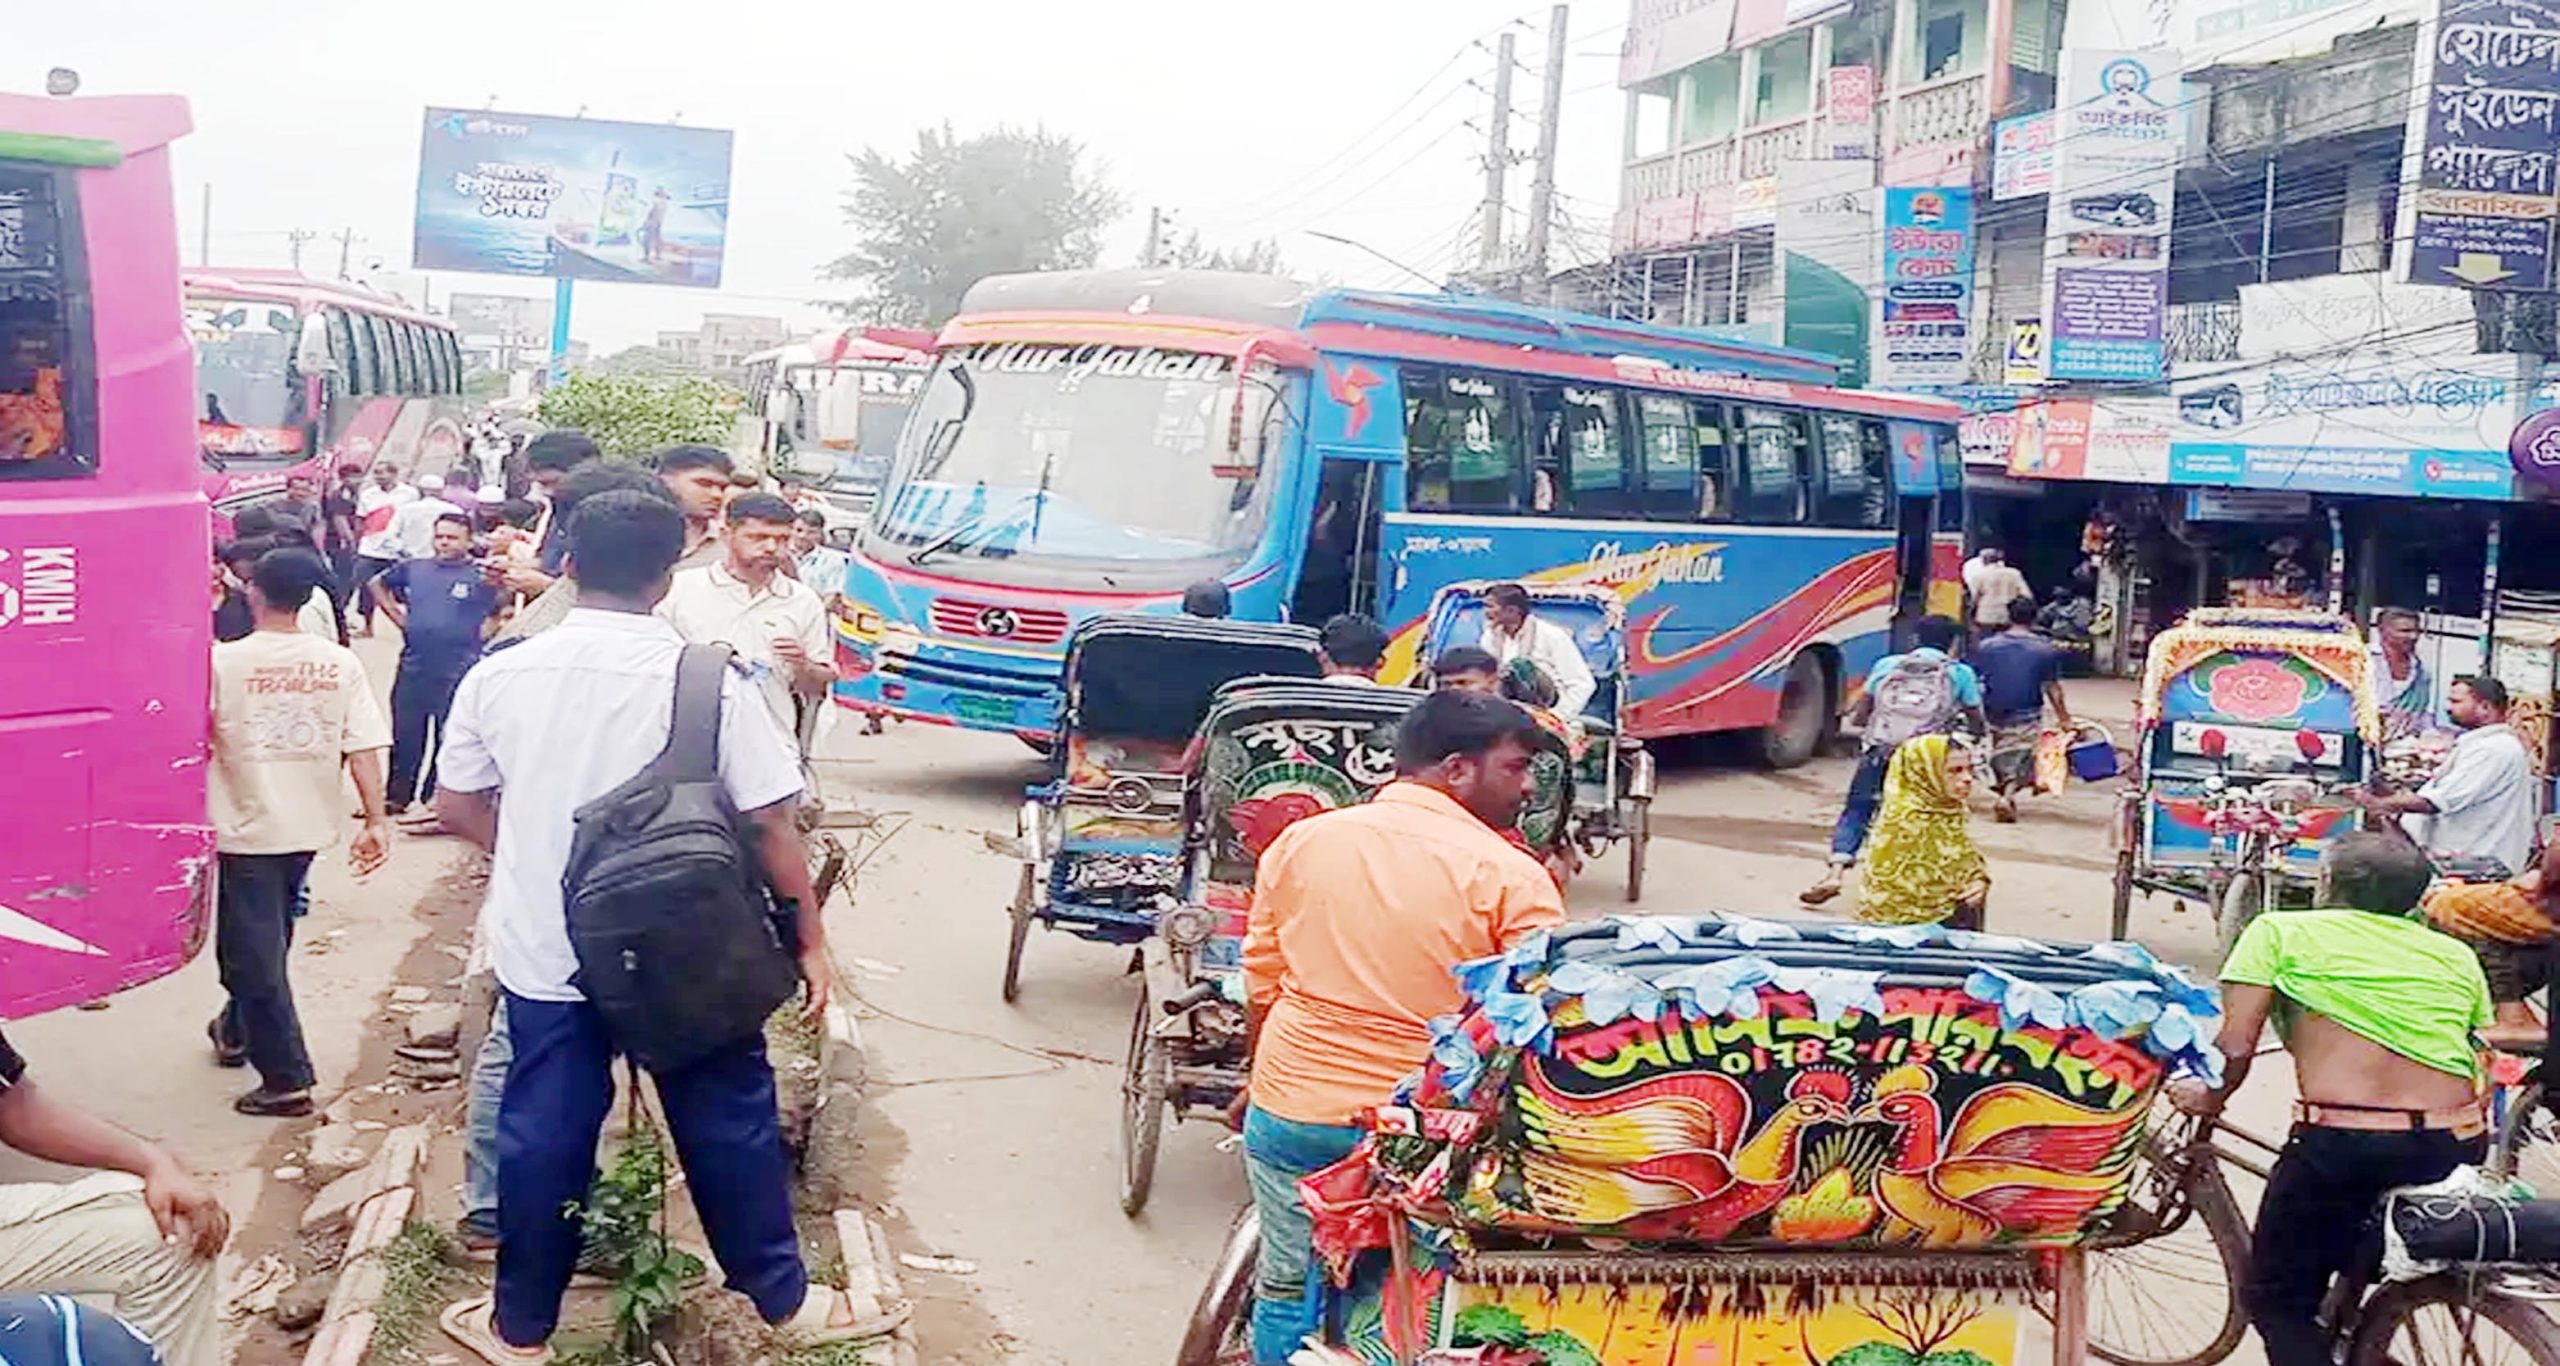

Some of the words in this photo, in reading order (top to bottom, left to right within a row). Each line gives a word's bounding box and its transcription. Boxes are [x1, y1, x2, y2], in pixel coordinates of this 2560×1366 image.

[2438, 11, 2560, 73] হোটেল
[2435, 71, 2560, 137] সুইডেন
[2427, 142, 2552, 194] প্যালেস
[1066, 343, 1223, 382] Jahan
